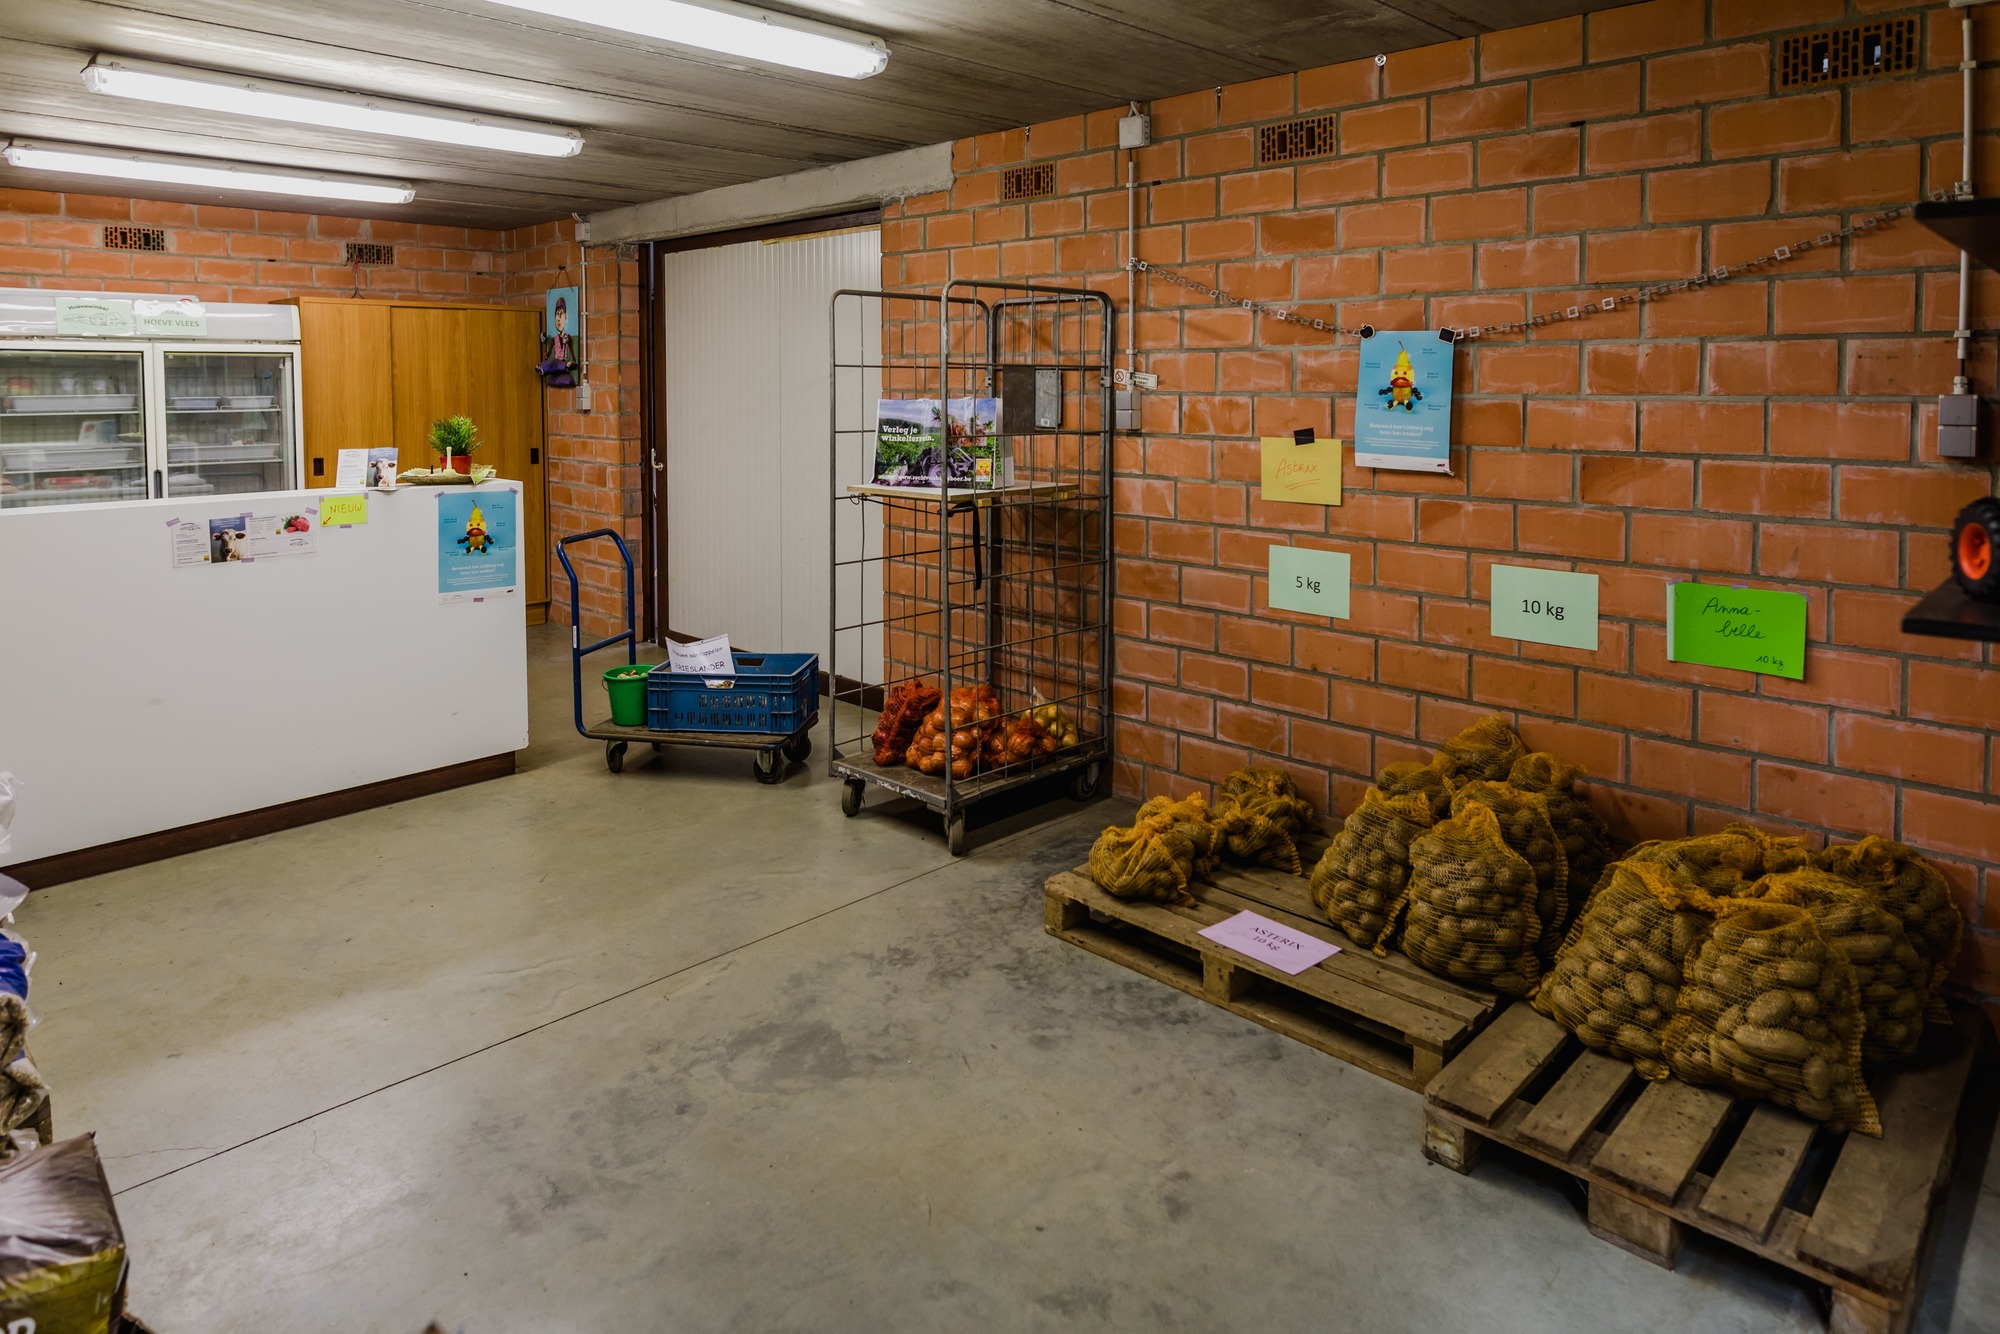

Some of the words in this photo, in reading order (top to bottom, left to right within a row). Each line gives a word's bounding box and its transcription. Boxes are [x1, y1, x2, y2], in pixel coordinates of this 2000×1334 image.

[144, 318, 173, 327] HOEVE
[175, 319, 200, 328] VLEES
[882, 425, 909, 435] Verleg
[910, 426, 918, 435] je
[330, 502, 363, 514] NIEUW
[1296, 576, 1303, 588] 5
[1306, 577, 1321, 594] kg
[1522, 599, 1541, 614] 10
[1546, 601, 1565, 621] kg
[1715, 620, 1767, 640] belle
[1756, 655, 1769, 663] 10
[1772, 656, 1784, 671] kg
[1249, 927, 1304, 950] ASTERIX
[1252, 936, 1267, 944] 10
